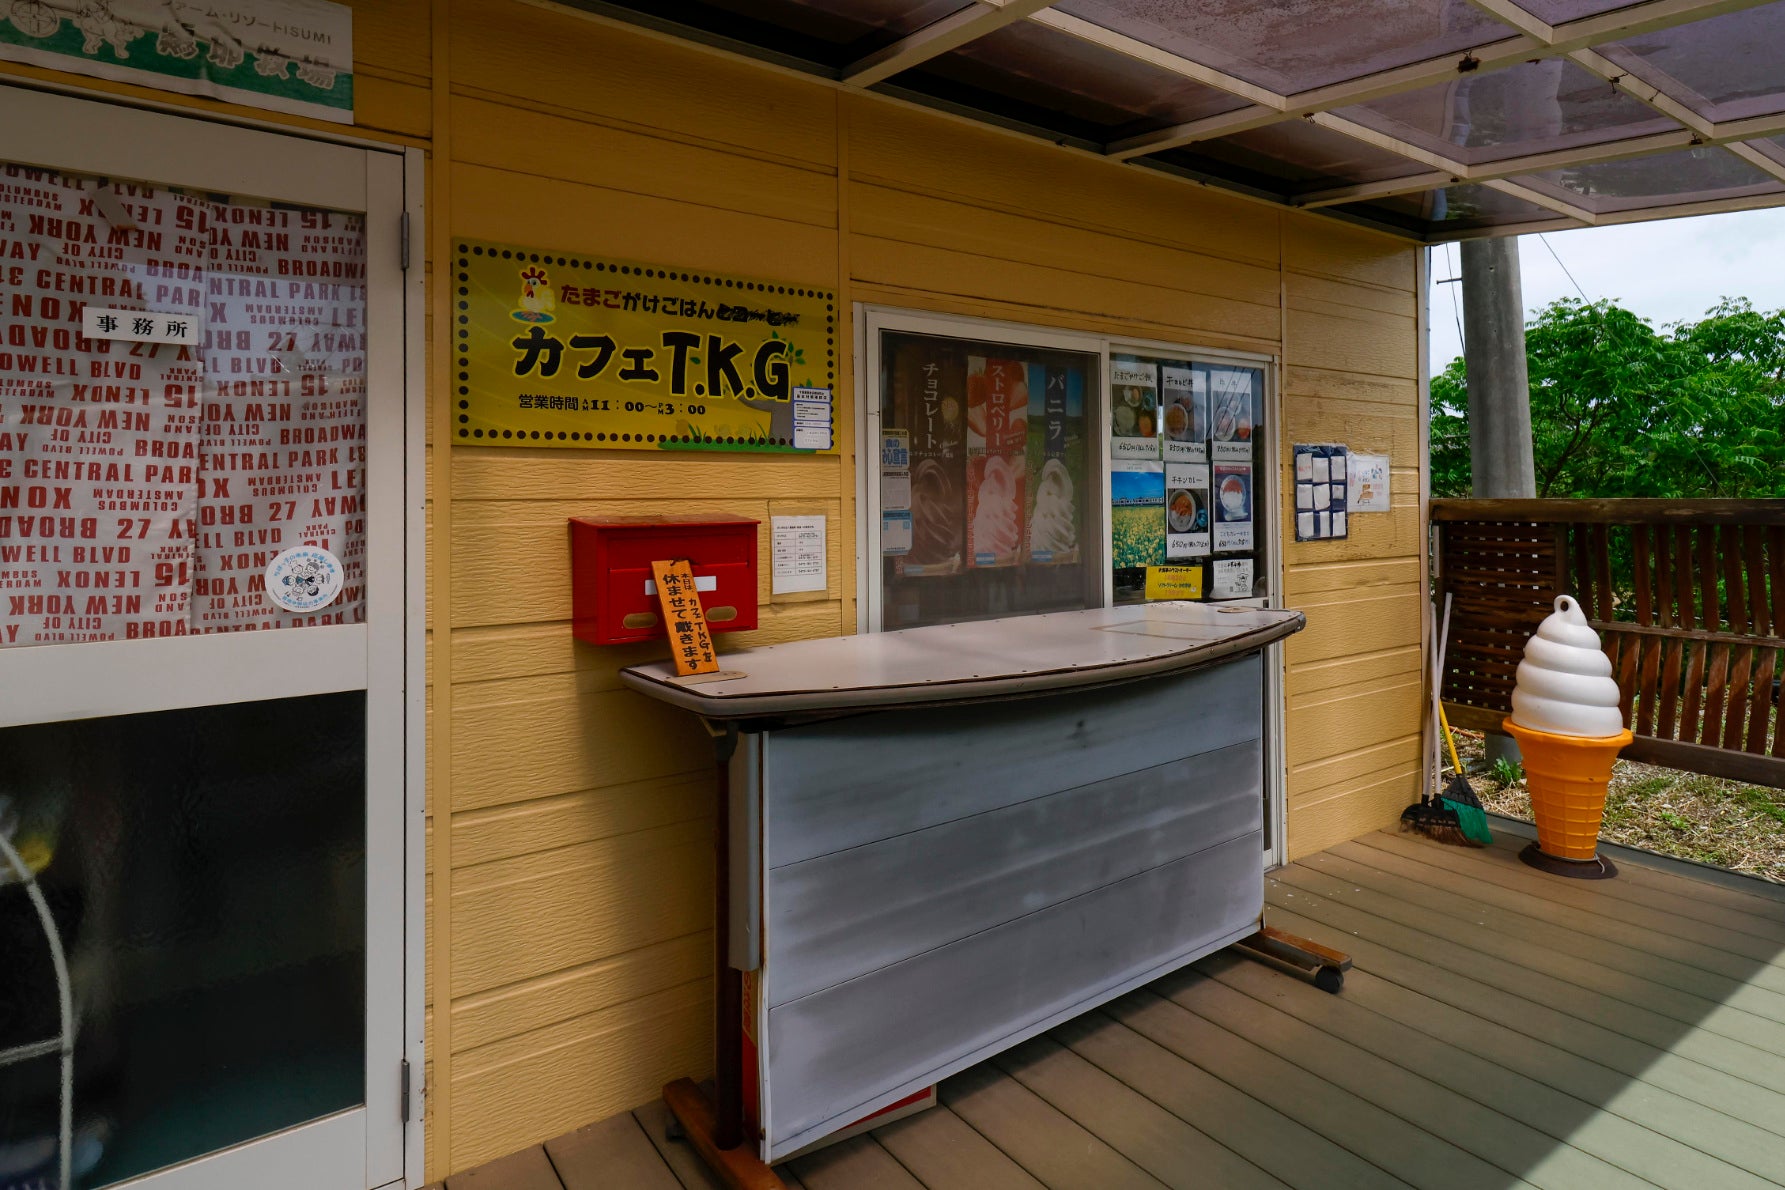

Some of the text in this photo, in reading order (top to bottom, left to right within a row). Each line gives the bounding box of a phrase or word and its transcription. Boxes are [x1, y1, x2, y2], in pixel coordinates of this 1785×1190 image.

[79, 198, 163, 226] LENX
[215, 206, 288, 229] LENOX
[29, 213, 98, 244] YORK
[108, 226, 162, 252] NEW
[241, 229, 290, 252] NEW
[62, 242, 124, 260] CITY OF
[226, 249, 257, 262] CITY
[90, 261, 136, 274] POWELL
[228, 264, 269, 275] POWELL
[37, 268, 145, 301] CENTRAL
[156, 284, 206, 309] PAR
[210, 278, 280, 299] NTRAL
[289, 282, 340, 302] PARK
[0, 292, 87, 323] NOX
[560, 284, 714, 320] たまごがけごはん
[96, 314, 188, 338] 事務所
[268, 332, 298, 351] 27
[91, 360, 142, 380] BLVD
[231, 357, 283, 374] BLVD
[216, 374, 328, 397] 15 LENOX
[71, 383, 198, 409] 15 LENOX
[518, 394, 580, 412] 営業時間
[922, 362, 940, 449] チョコレート
[991, 364, 1006, 447] ストロベリー
[245, 403, 292, 422] NEW
[1047, 374, 1065, 441] バニラ
[20, 404, 151, 432] NEW YORK
[51, 428, 112, 444] CITY OF
[205, 424, 260, 436] CITY OF
[42, 444, 123, 456] POWELL BLVD
[231, 438, 272, 447] POWELL
[289, 447, 339, 469] PARK
[24, 459, 134, 481] CENTRAL
[145, 464, 197, 484] PAR
[248, 473, 321, 487] AMSTERDAM
[93, 488, 184, 501] AMSTERDAM
[253, 483, 317, 497] COLUMBUS
[98, 500, 178, 512] COLUMBUS
[269, 500, 297, 522] 27
[117, 518, 152, 540] 27
[234, 527, 282, 547] BLVD
[73, 546, 131, 564] BLVD
[220, 550, 281, 571] ENOX
[57, 570, 140, 588] LENOX
[154, 562, 190, 588] 15
[9, 594, 141, 617] NEW YORK
[209, 594, 263, 610] CITY OF
[43, 616, 102, 630] CITY OF
[203, 607, 274, 621] POWELL BLVD
[35, 631, 115, 642] POWELL BLVD
